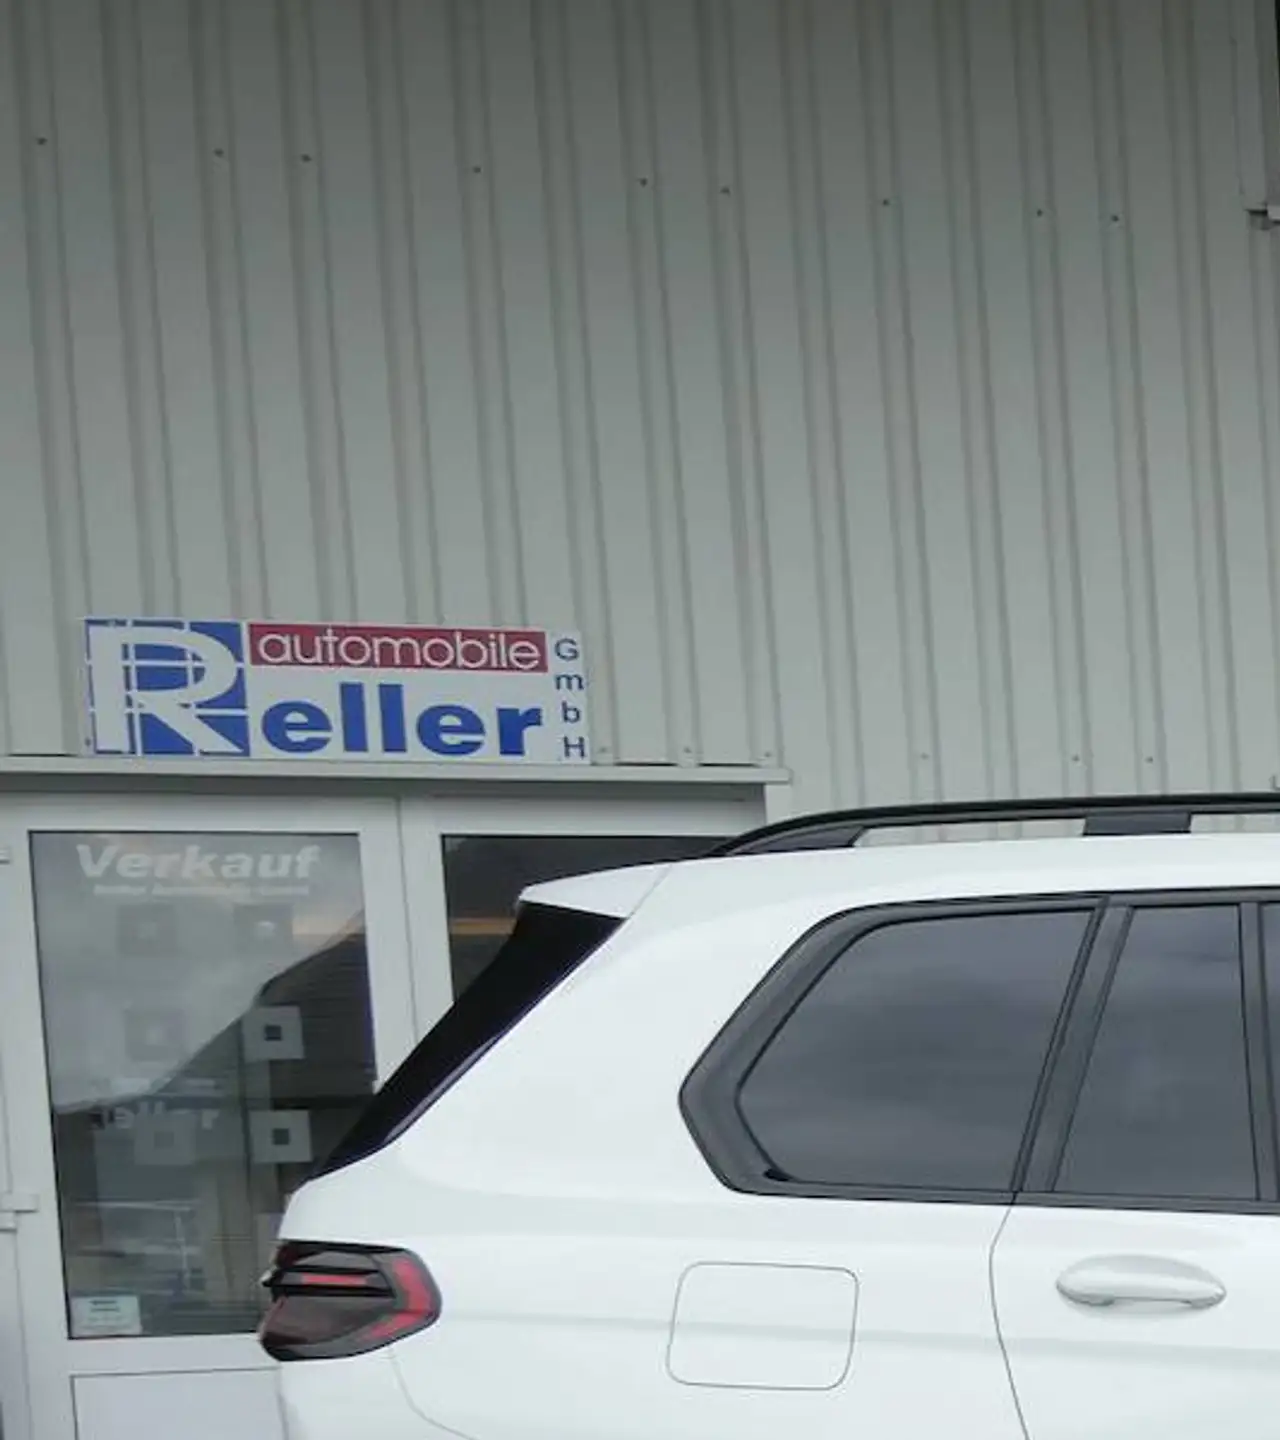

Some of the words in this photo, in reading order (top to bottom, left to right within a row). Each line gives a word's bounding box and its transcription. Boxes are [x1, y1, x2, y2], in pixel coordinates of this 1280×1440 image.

[258, 628, 541, 670] automobile
[87, 624, 543, 757] Reller
[554, 637, 585, 759] GmbH
[76, 843, 321, 879] Verkauf
